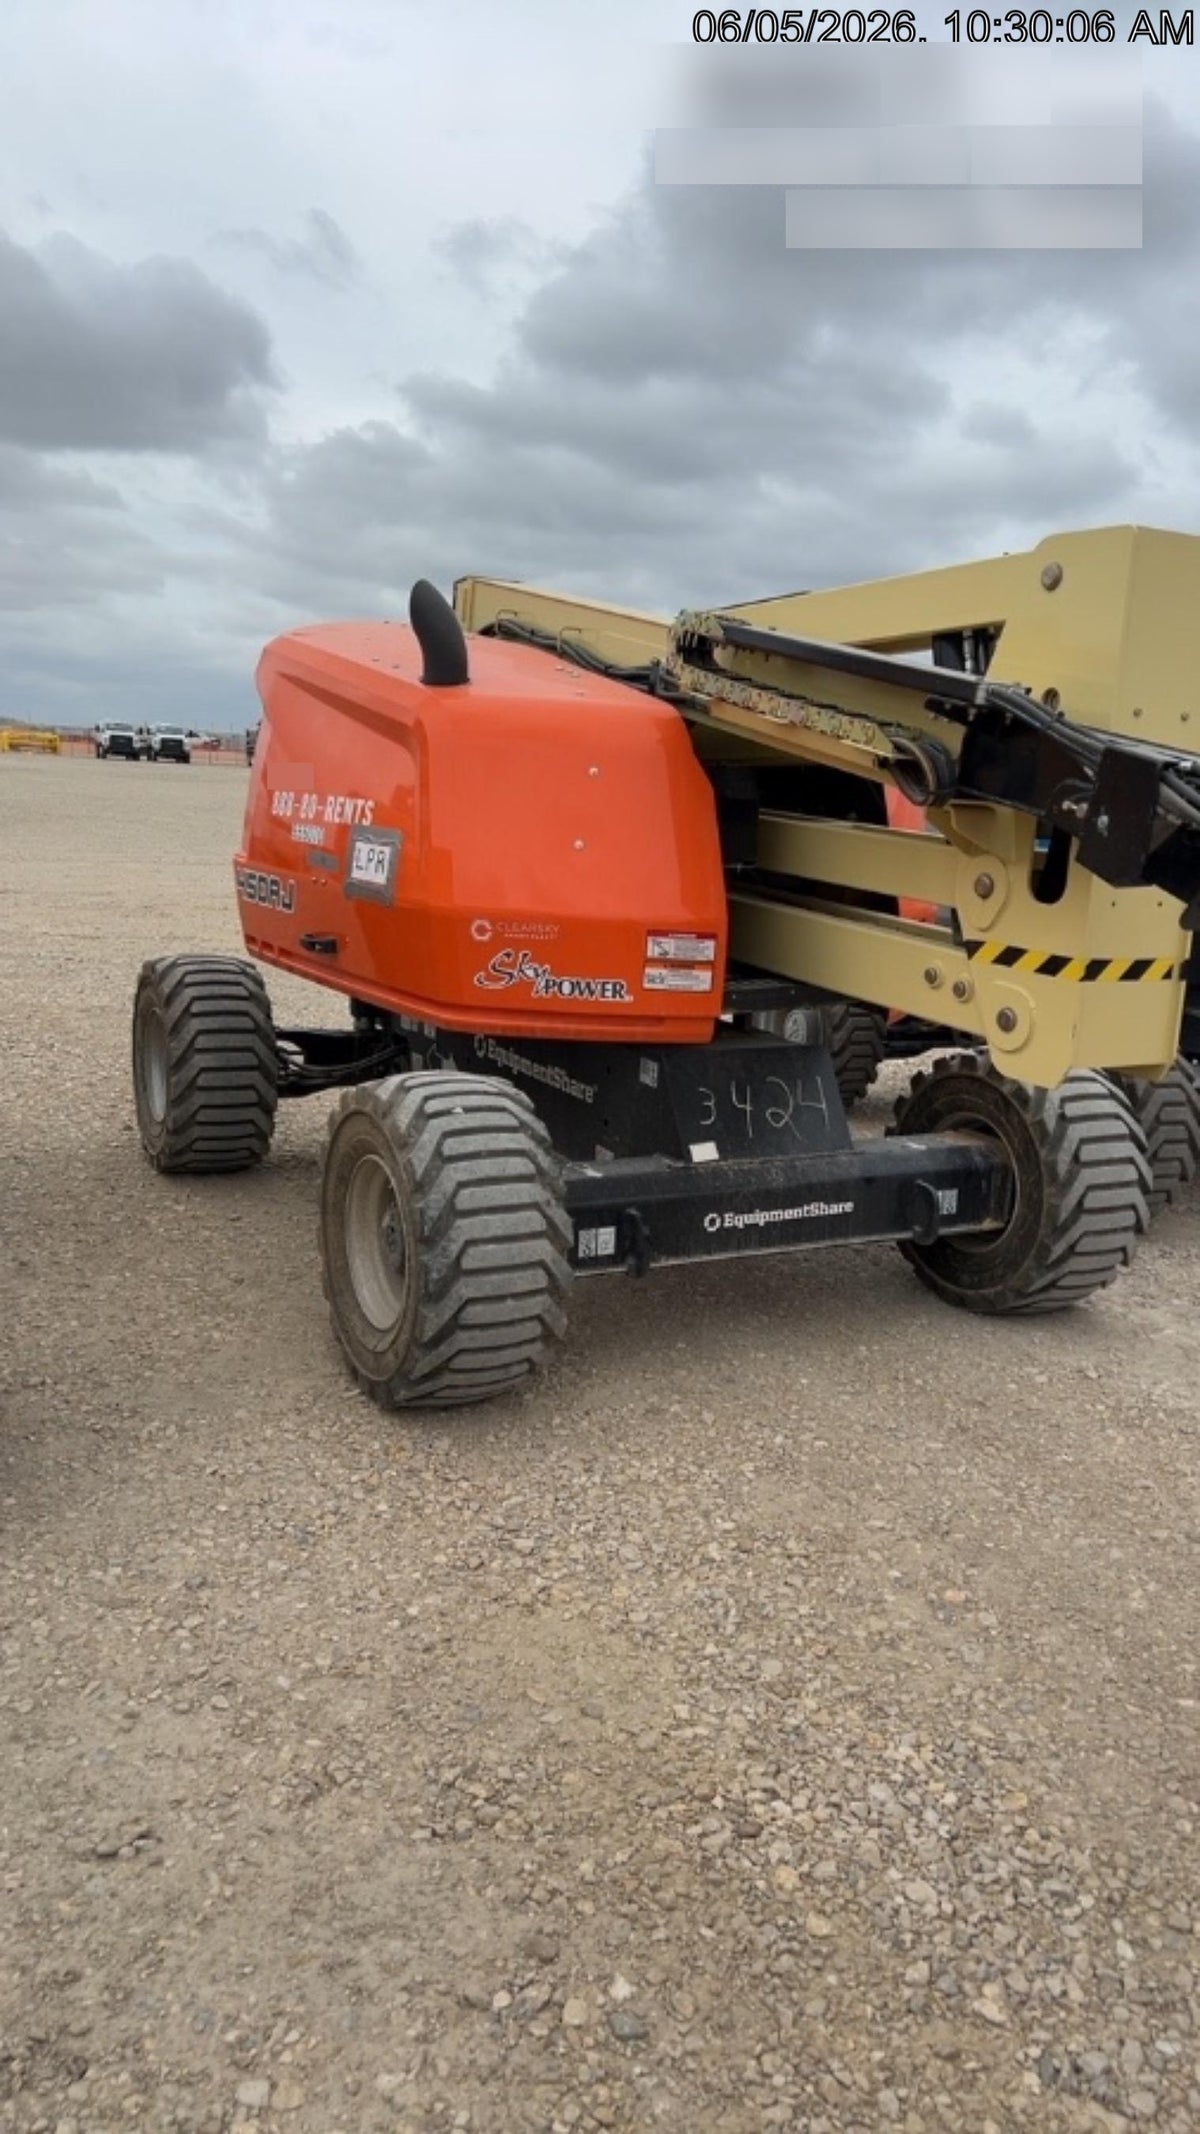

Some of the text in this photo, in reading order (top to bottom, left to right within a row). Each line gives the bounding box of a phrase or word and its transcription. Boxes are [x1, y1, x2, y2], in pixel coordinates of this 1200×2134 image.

[354, 848, 388, 876] LPR
[541, 976, 628, 1000] POWER
[699, 1076, 830, 1143] 3424
[723, 1201, 854, 1229] EquipmentShare
